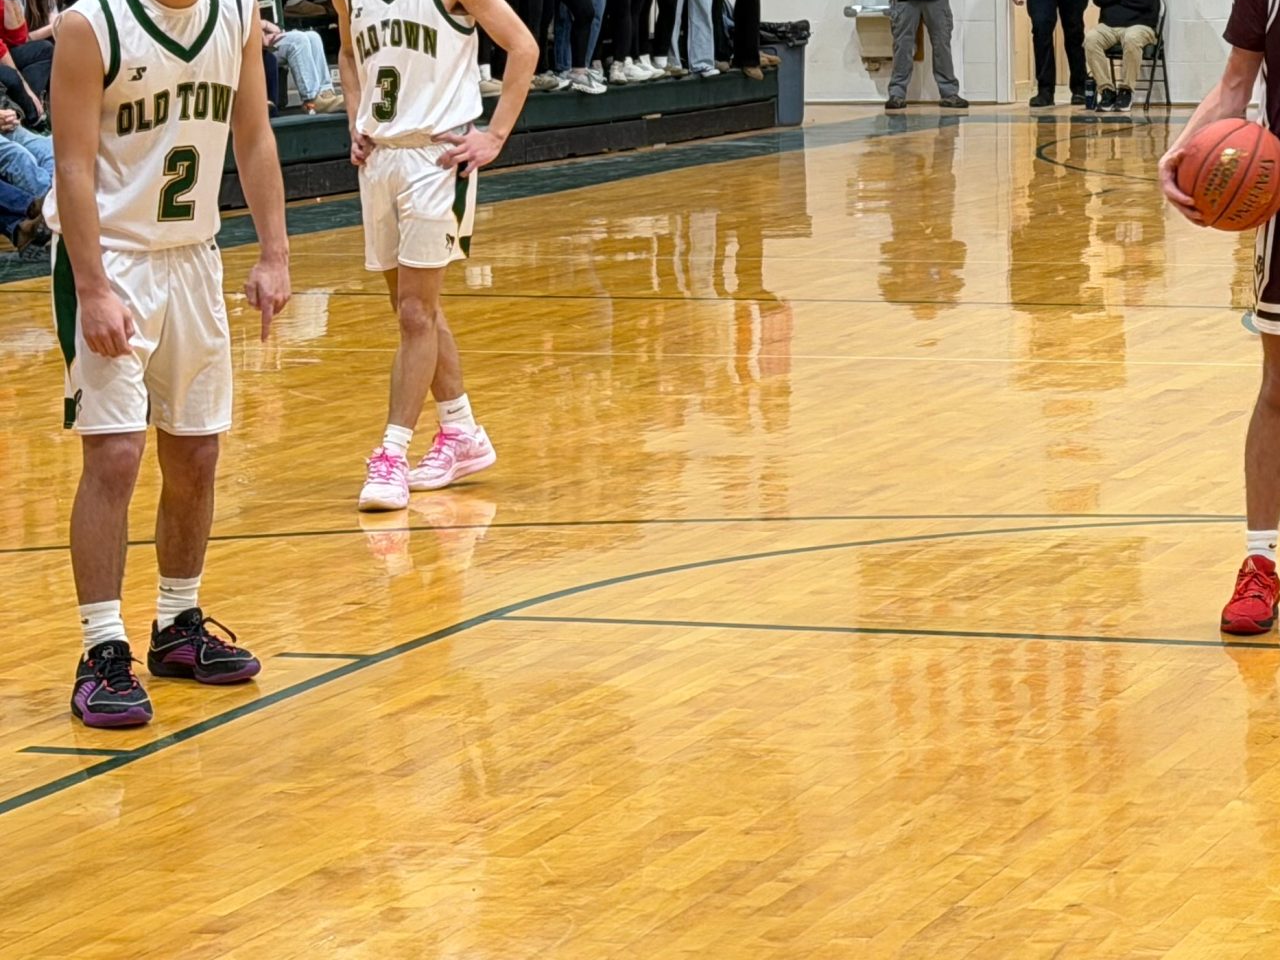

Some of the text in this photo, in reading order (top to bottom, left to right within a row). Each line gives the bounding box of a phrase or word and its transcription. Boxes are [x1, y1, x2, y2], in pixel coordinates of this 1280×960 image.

[356, 18, 438, 66] OLD TOWN
[116, 81, 236, 138] OLD TOW
[371, 65, 401, 123] 3
[156, 144, 200, 223] 2
